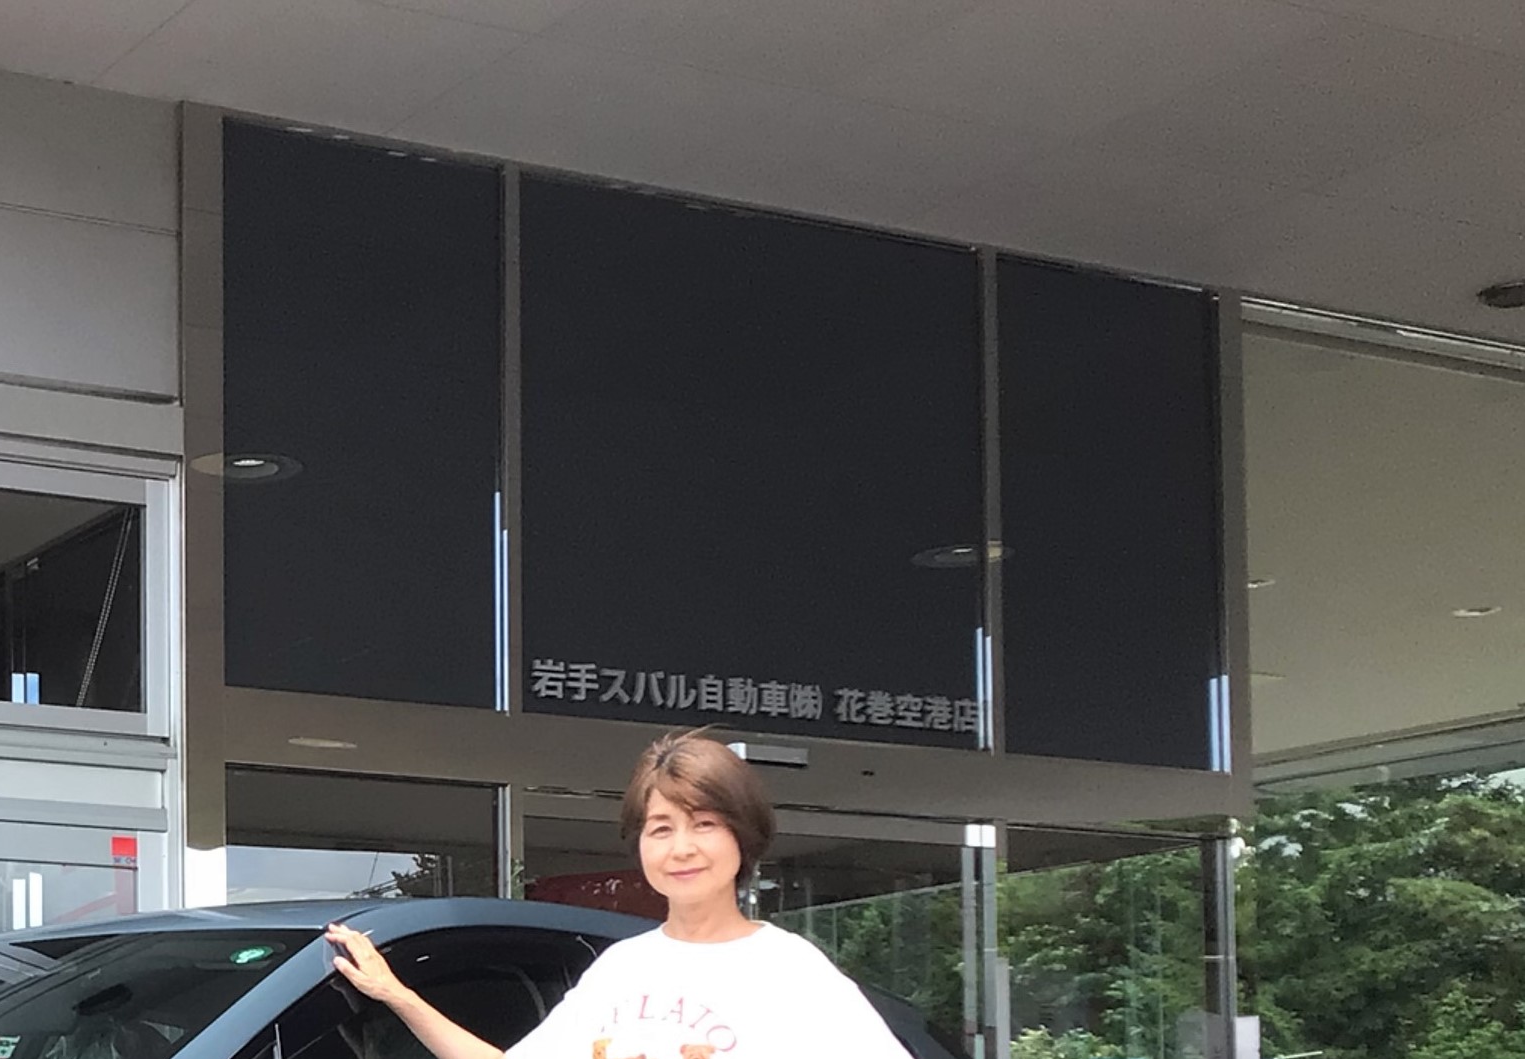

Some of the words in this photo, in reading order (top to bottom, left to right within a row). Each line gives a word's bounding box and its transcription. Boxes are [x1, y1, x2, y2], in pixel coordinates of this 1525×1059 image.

[834, 687, 980, 733] 花巻空港店
[599, 995, 737, 1052] LATO
